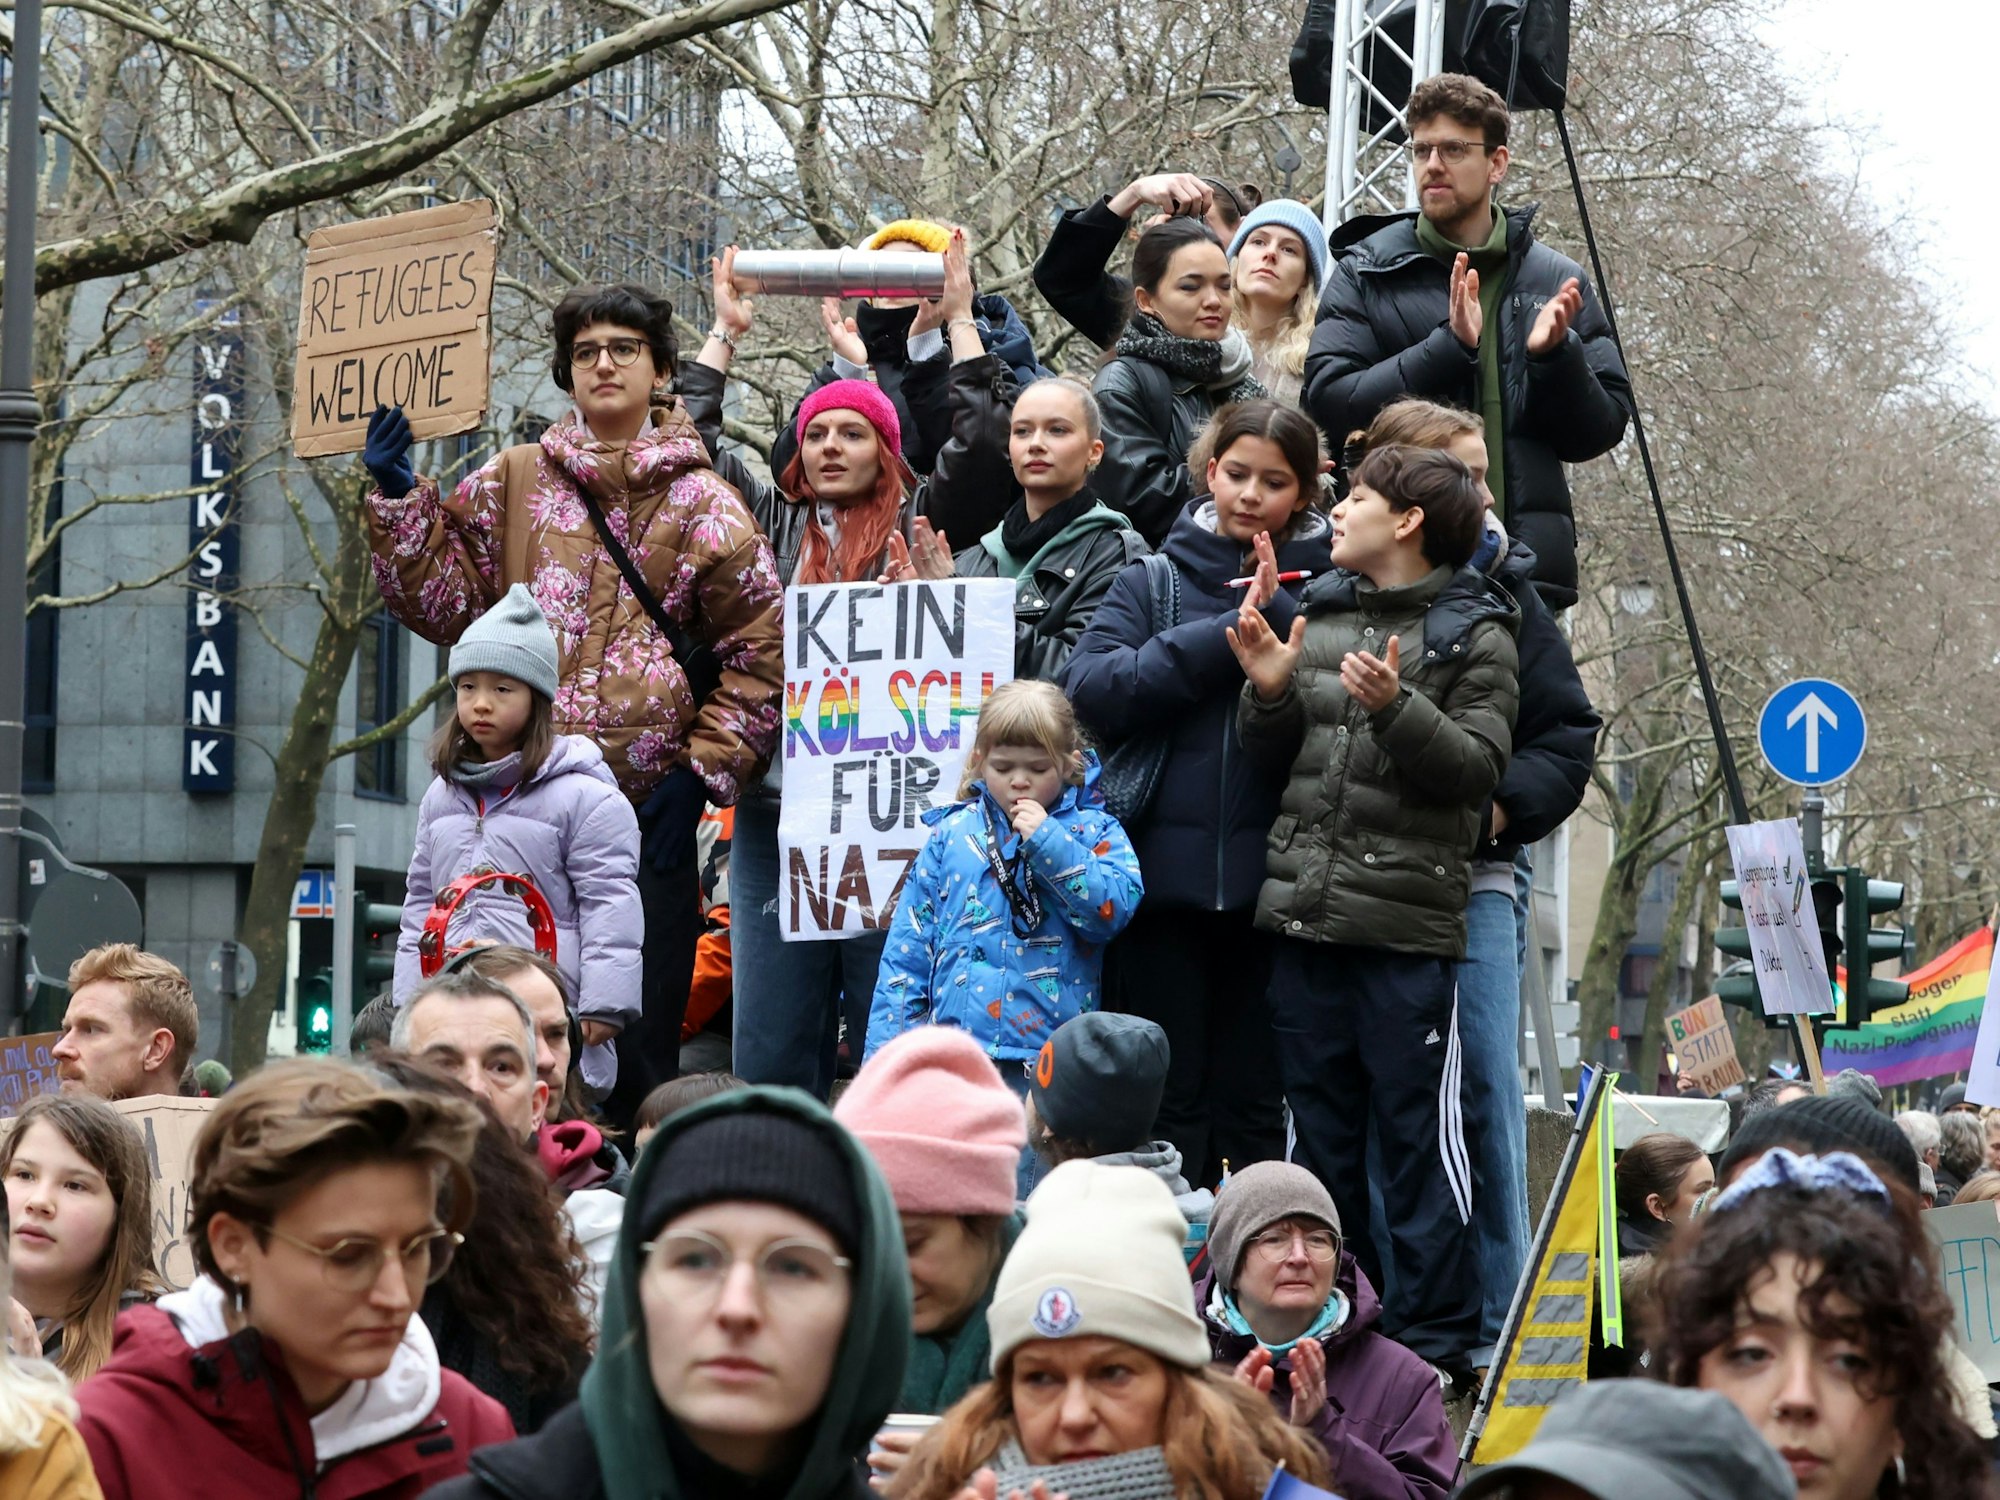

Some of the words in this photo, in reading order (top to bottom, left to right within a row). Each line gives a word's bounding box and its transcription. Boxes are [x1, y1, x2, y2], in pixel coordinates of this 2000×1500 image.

[309, 250, 477, 339] REFUGEES
[310, 341, 461, 427] WELCOME
[189, 344, 232, 776] VOLKSBANK
[796, 583, 967, 670] KEIN
[785, 666, 994, 759] KÖLSCH
[829, 749, 942, 834] FÜR
[787, 844, 920, 934] NAZ
[1671, 999, 1716, 1041] BUNT
[1682, 1025, 1729, 1071] STATT
